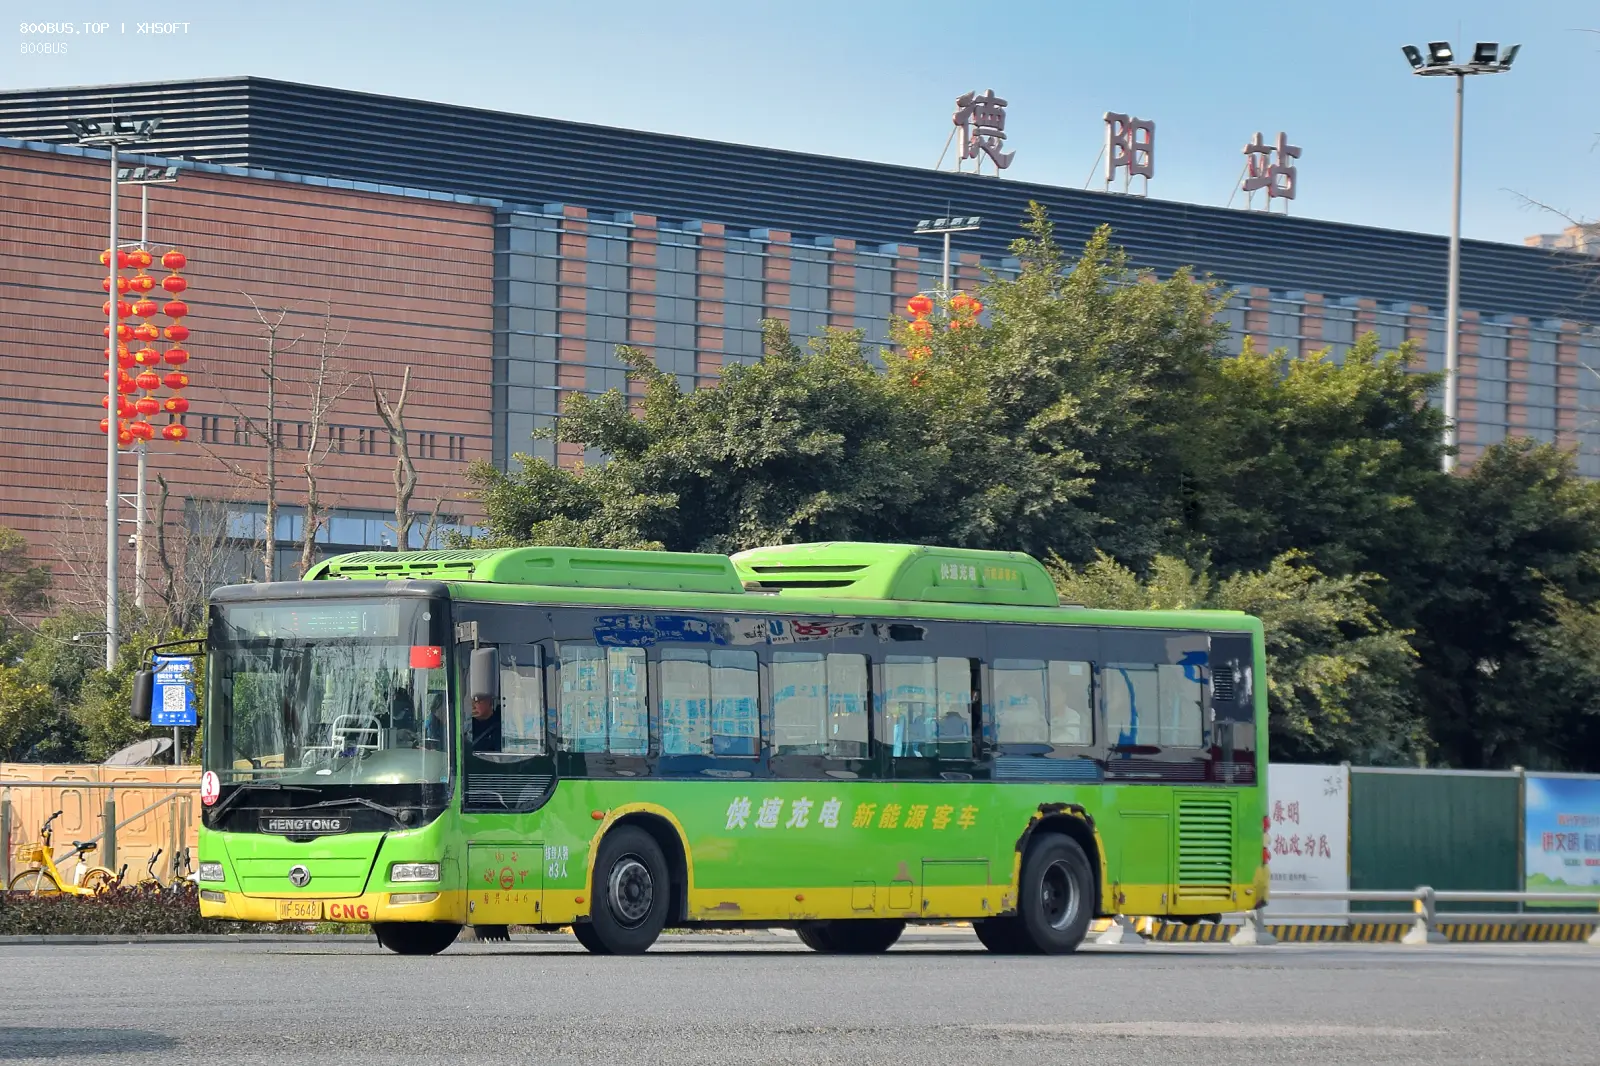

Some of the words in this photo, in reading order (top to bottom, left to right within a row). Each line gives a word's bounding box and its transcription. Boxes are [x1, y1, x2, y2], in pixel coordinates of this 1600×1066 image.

[953, 88, 1303, 200] 德阳站
[206, 772, 213, 796] 3
[268, 819, 340, 831] HENGTONG
[725, 797, 842, 829] 快速充电
[852, 803, 979, 830] 新能源客车
[1274, 833, 1331, 859] 执政为民
[330, 904, 370, 919] CNG
